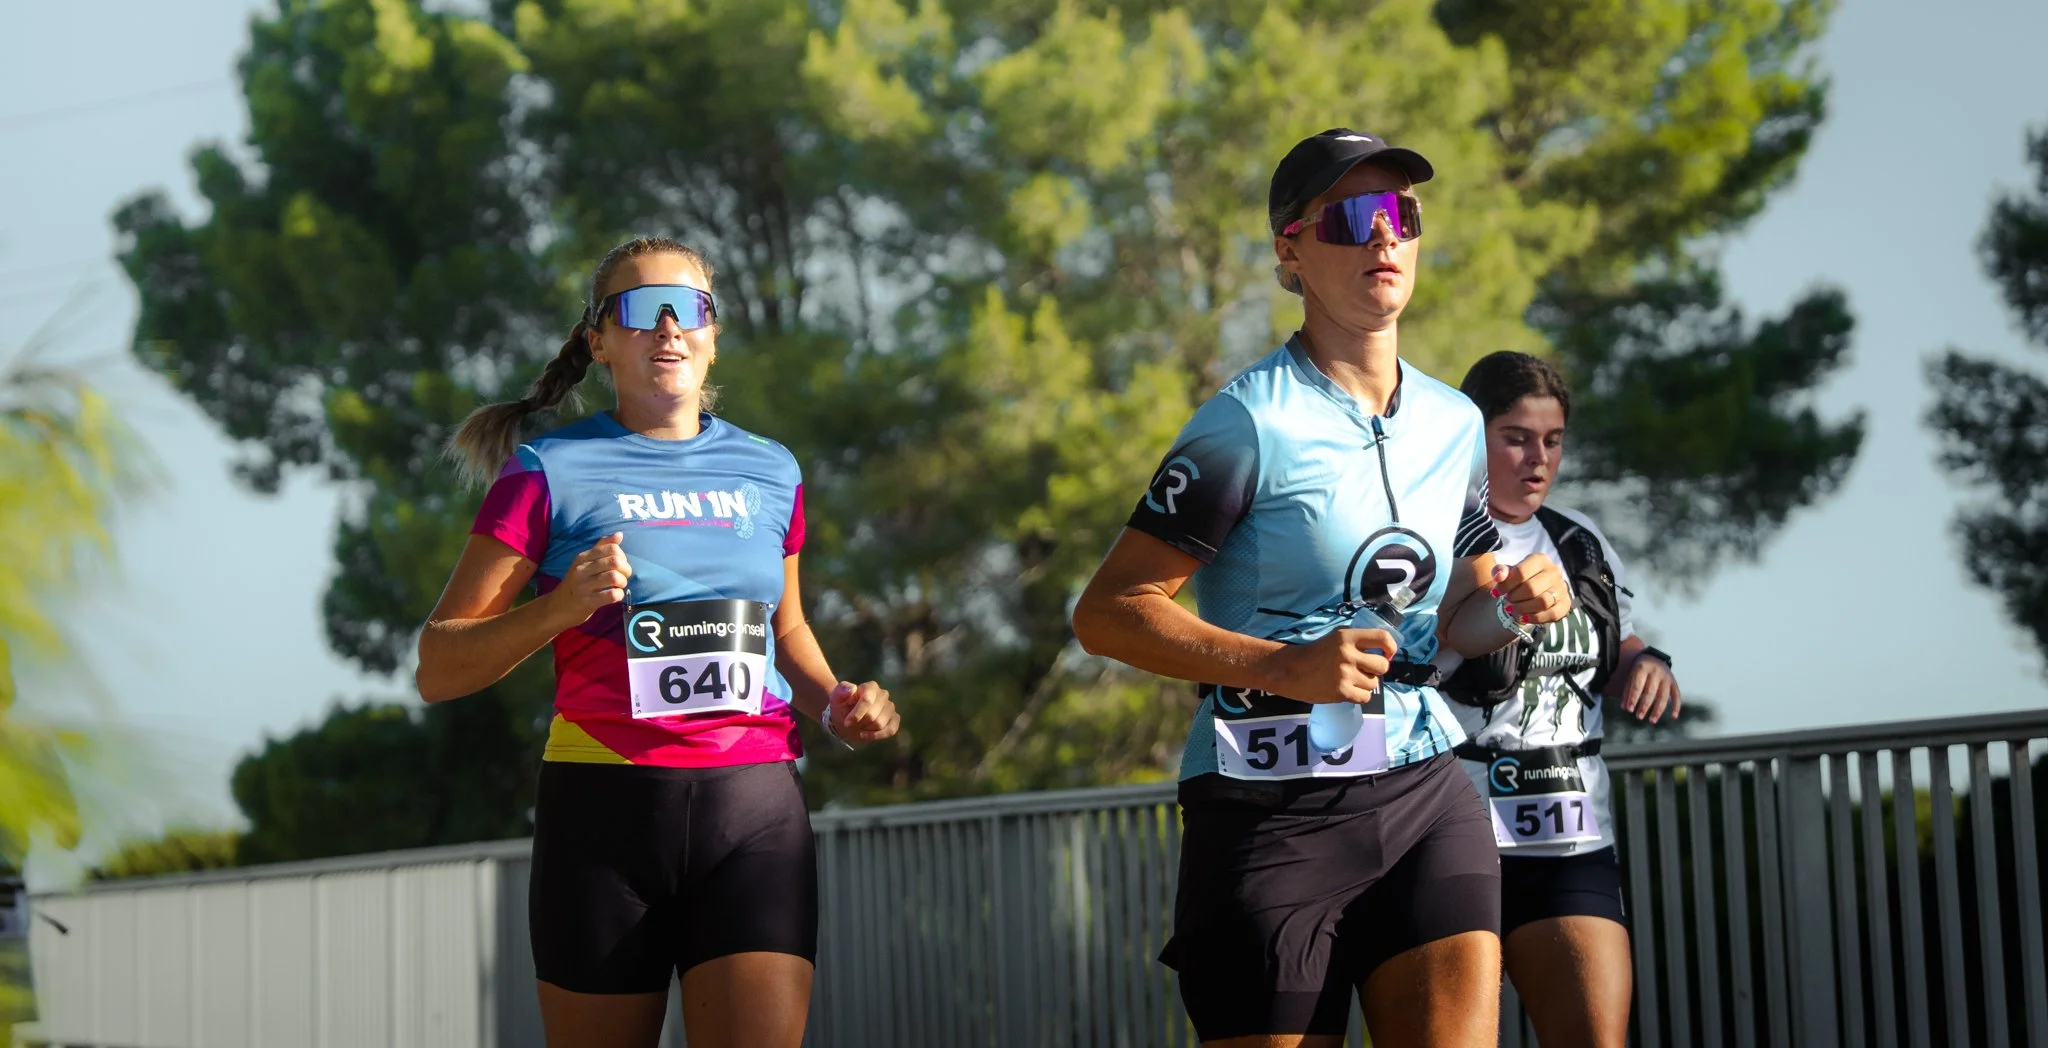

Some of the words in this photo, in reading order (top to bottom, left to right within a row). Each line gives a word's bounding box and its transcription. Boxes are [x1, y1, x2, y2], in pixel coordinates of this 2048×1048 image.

[669, 620, 765, 638] runningconseil
[658, 661, 751, 704] 640
[1515, 800, 1584, 837] 517
